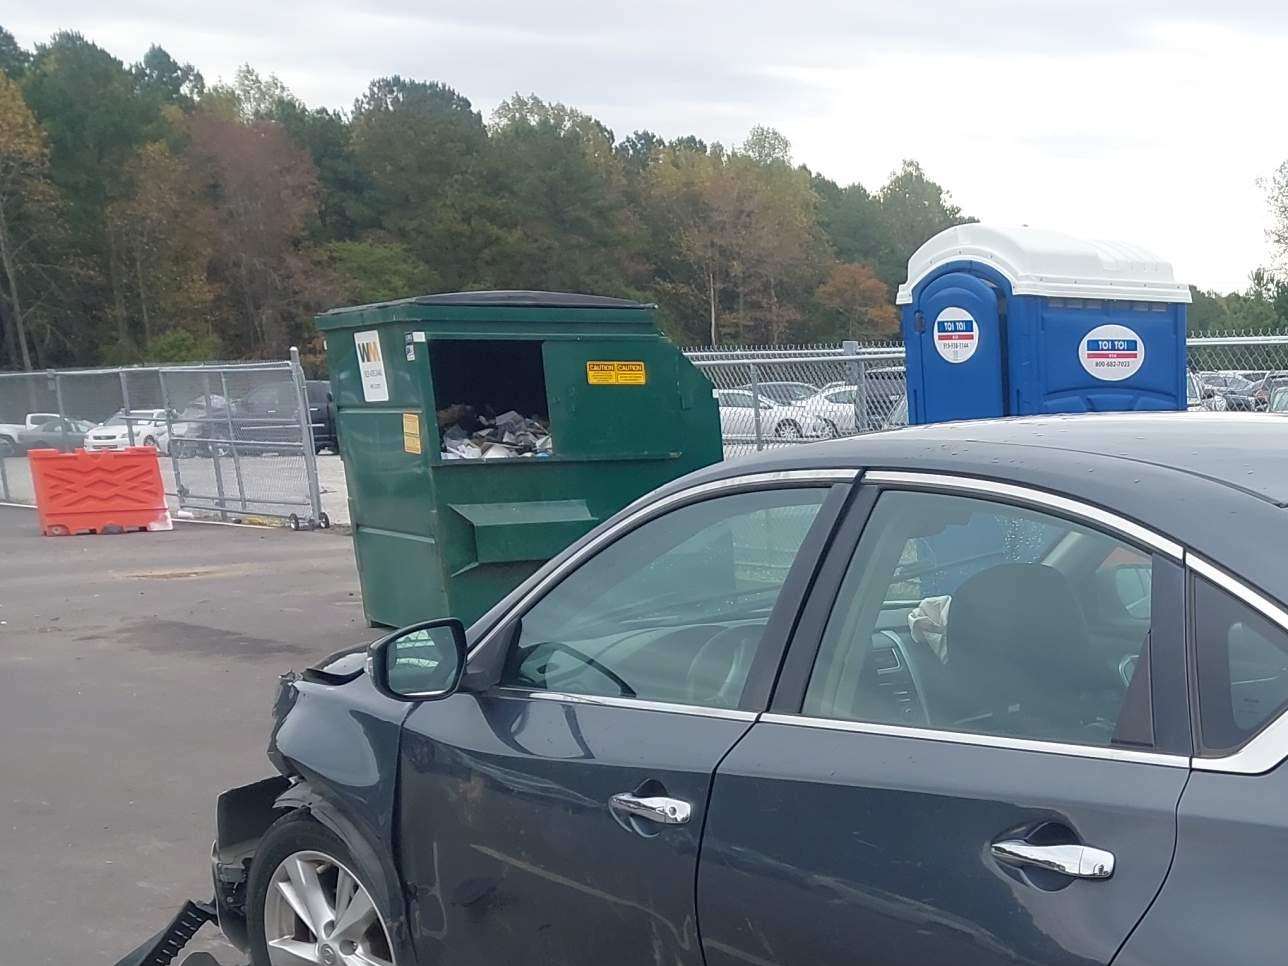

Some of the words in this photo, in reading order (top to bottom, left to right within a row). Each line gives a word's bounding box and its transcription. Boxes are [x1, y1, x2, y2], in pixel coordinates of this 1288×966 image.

[944, 321, 954, 331] TOI
[956, 321, 966, 331] TOI
[1098, 340, 1111, 350] TOI
[1114, 340, 1127, 350] TOI
